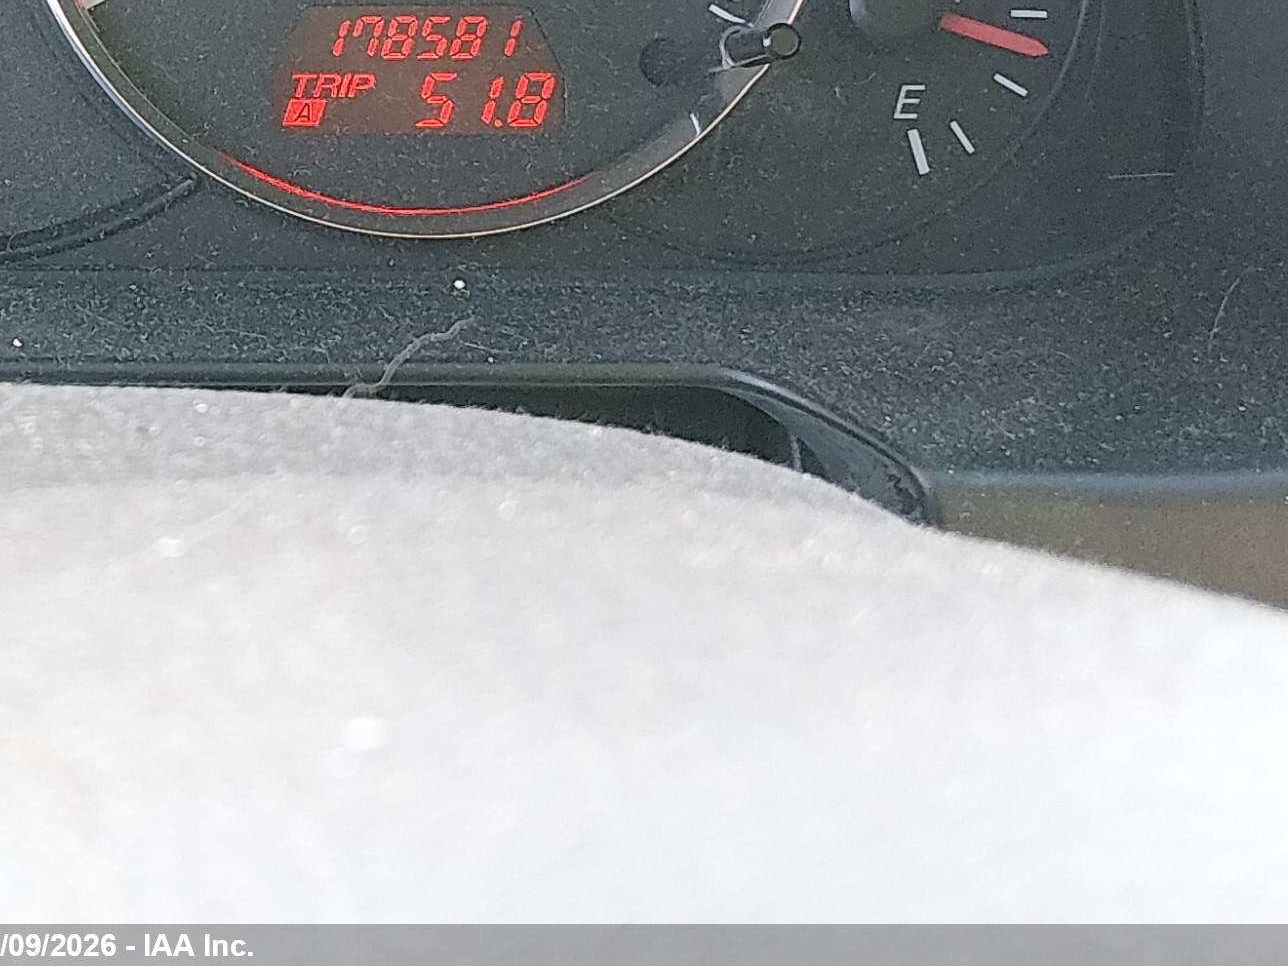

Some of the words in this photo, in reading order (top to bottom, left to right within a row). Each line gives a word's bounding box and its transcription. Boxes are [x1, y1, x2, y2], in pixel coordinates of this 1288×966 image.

[332, 15, 524, 61] 178581
[292, 73, 376, 98] TRIP
[893, 84, 926, 119] E
